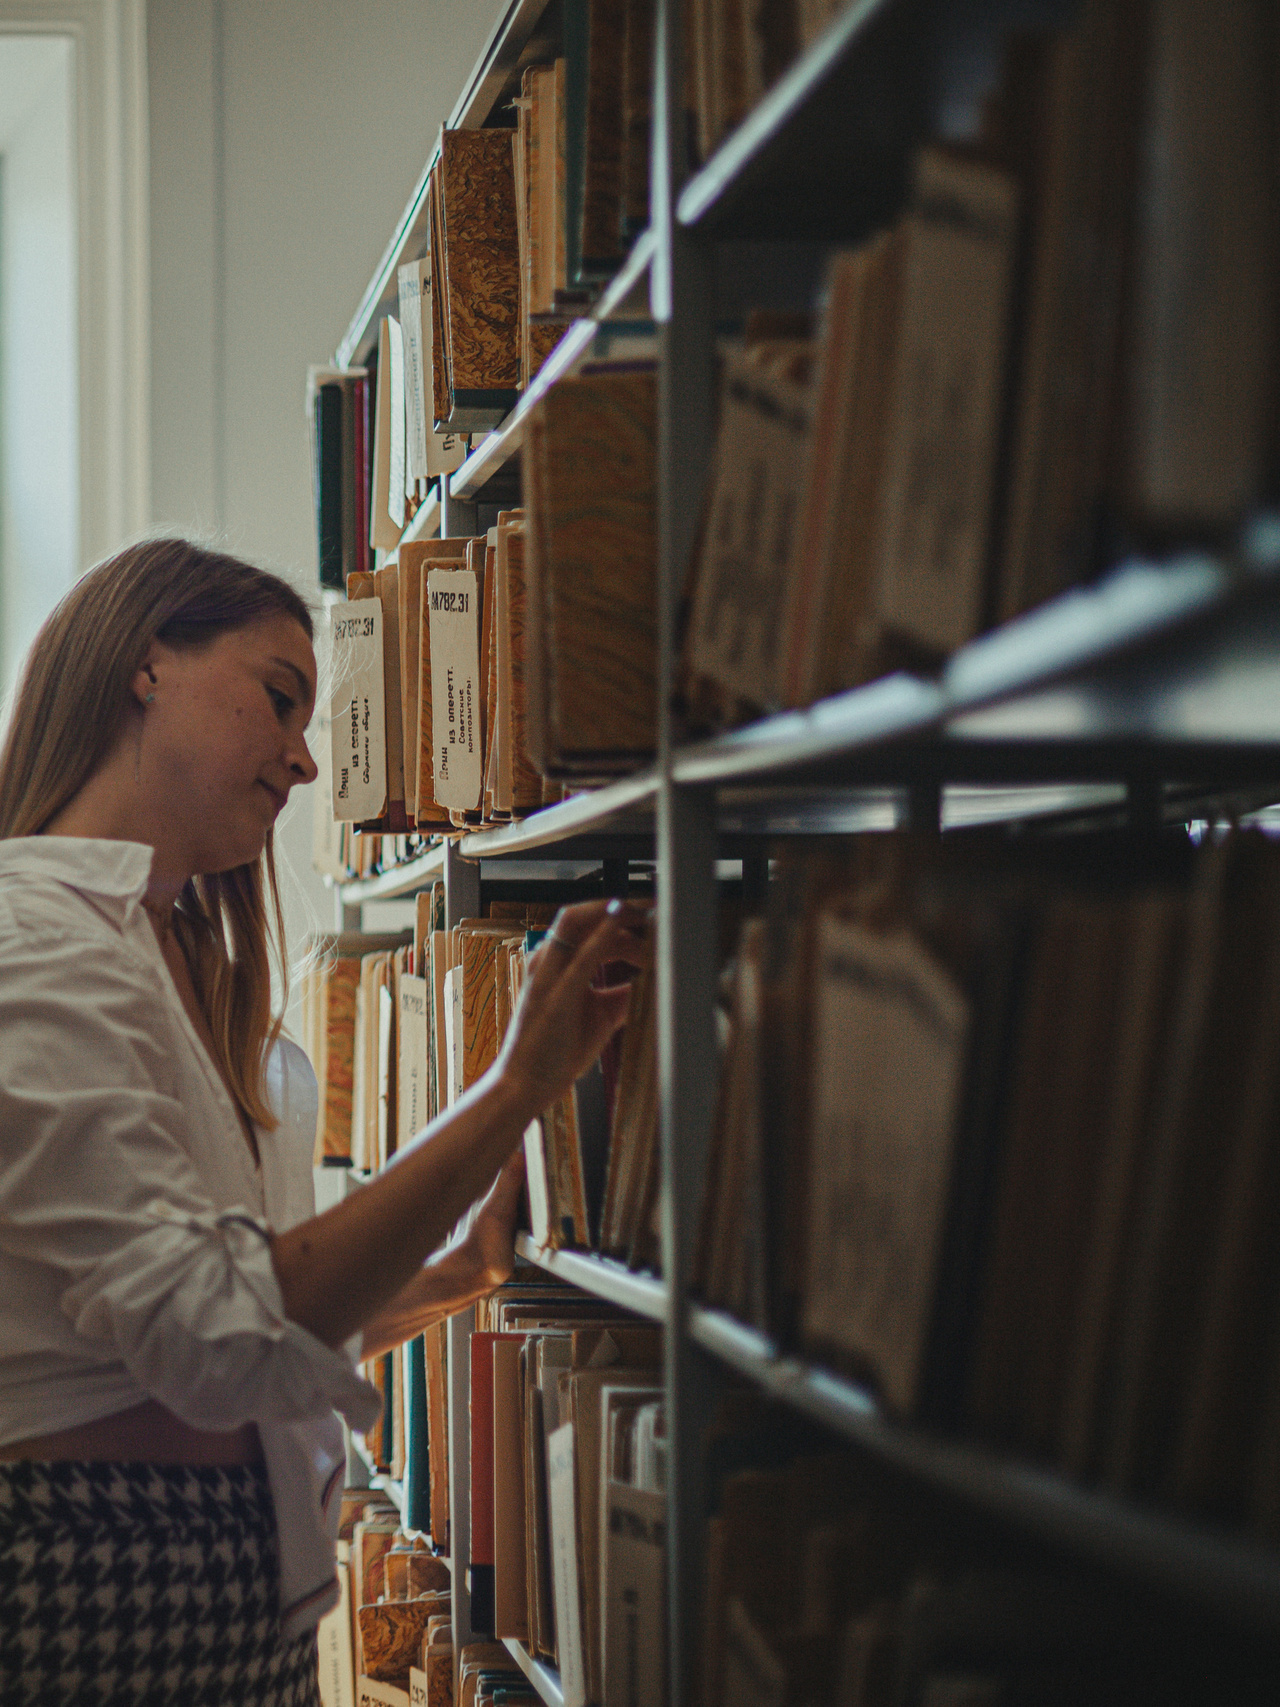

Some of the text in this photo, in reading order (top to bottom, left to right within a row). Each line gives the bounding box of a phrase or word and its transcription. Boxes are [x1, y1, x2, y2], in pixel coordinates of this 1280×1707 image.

[447, 665, 456, 744] из оперетт.
[458, 688, 466, 744] Советские
[352, 754, 359, 768] из
